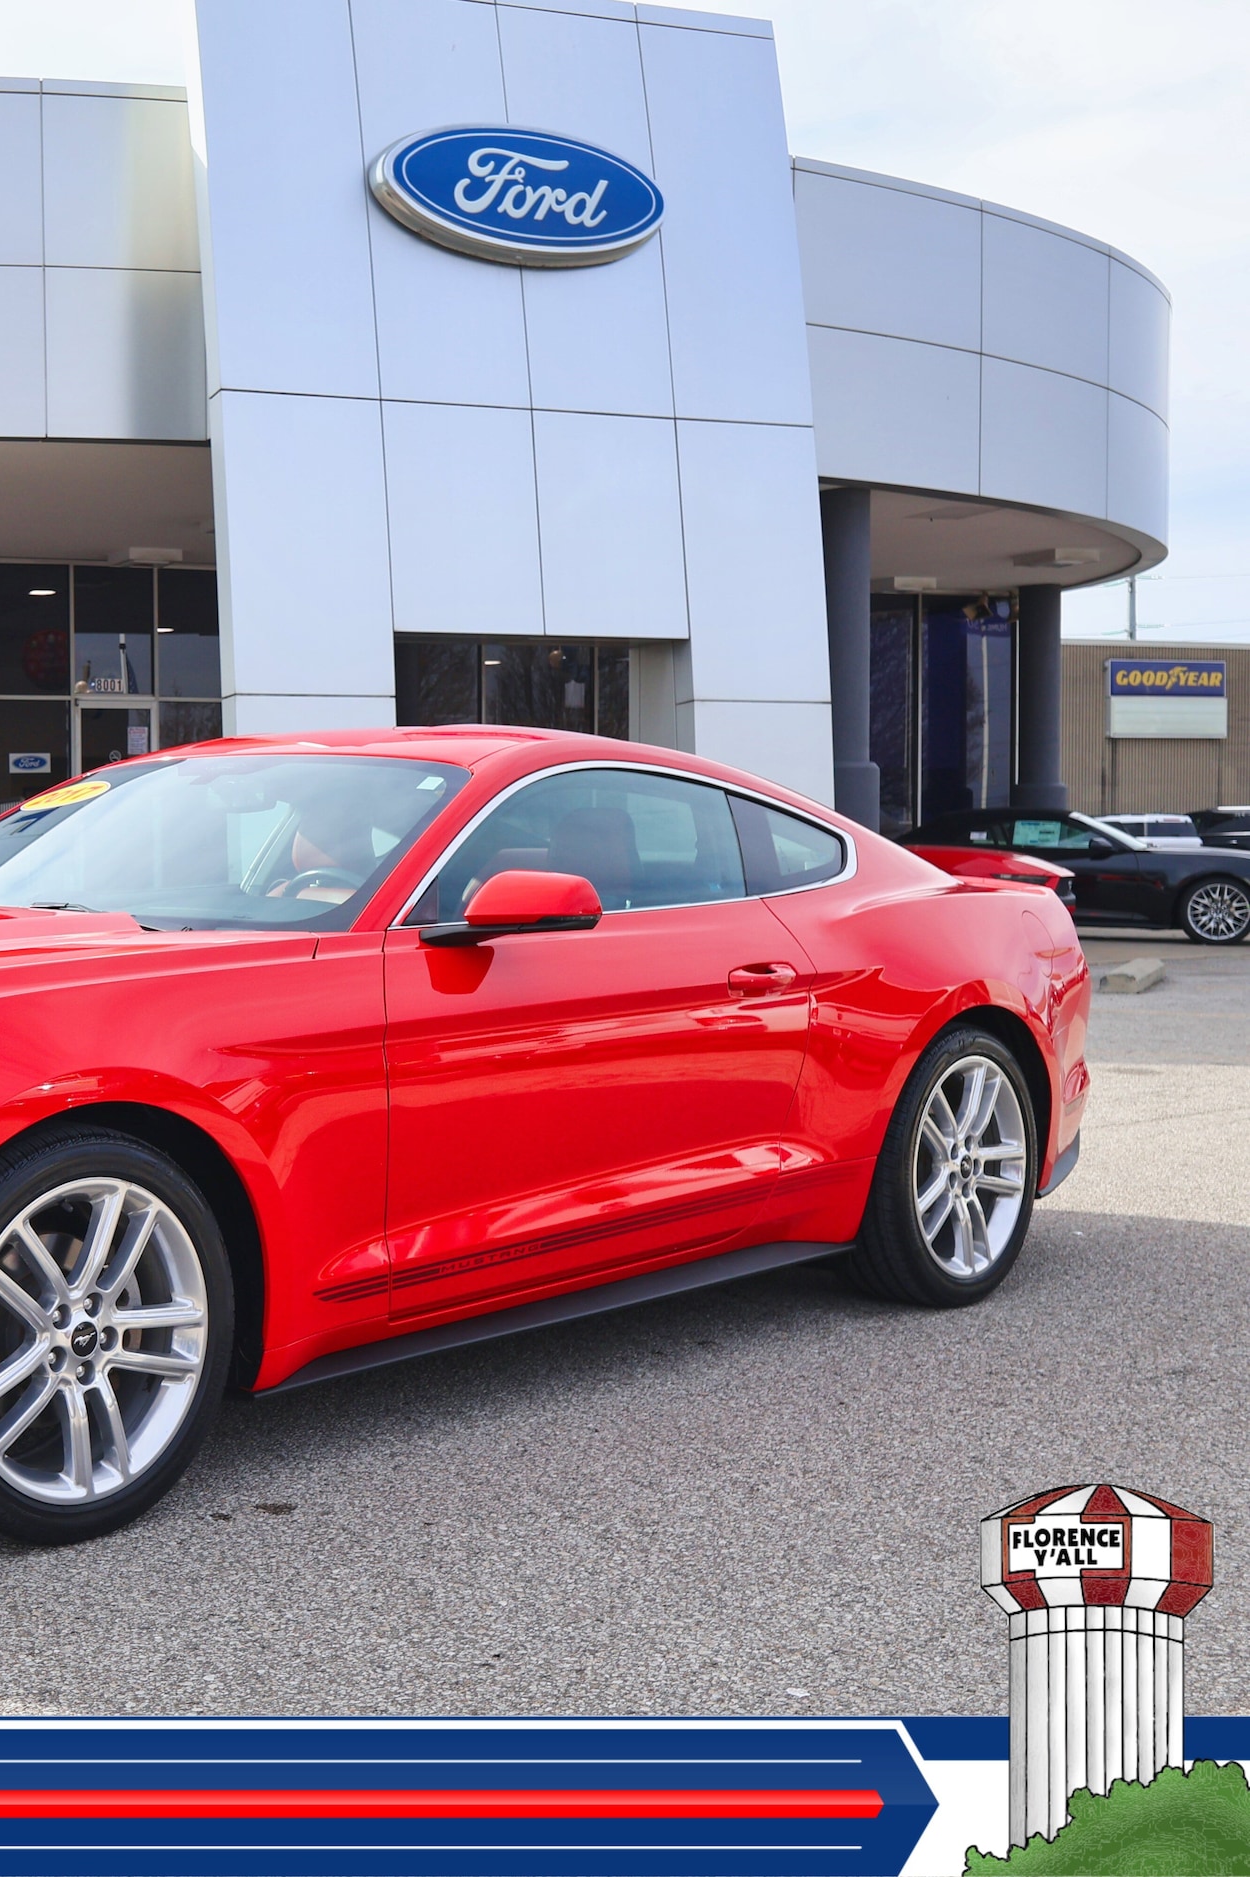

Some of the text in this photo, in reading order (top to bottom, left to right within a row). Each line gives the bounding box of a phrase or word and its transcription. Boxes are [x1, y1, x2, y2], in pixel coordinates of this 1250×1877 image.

[453, 147, 608, 228] Ford
[96, 679, 121, 691] 8001
[1116, 667, 1223, 688] GOODYEAR
[440, 1242, 541, 1274] MUSTANG
